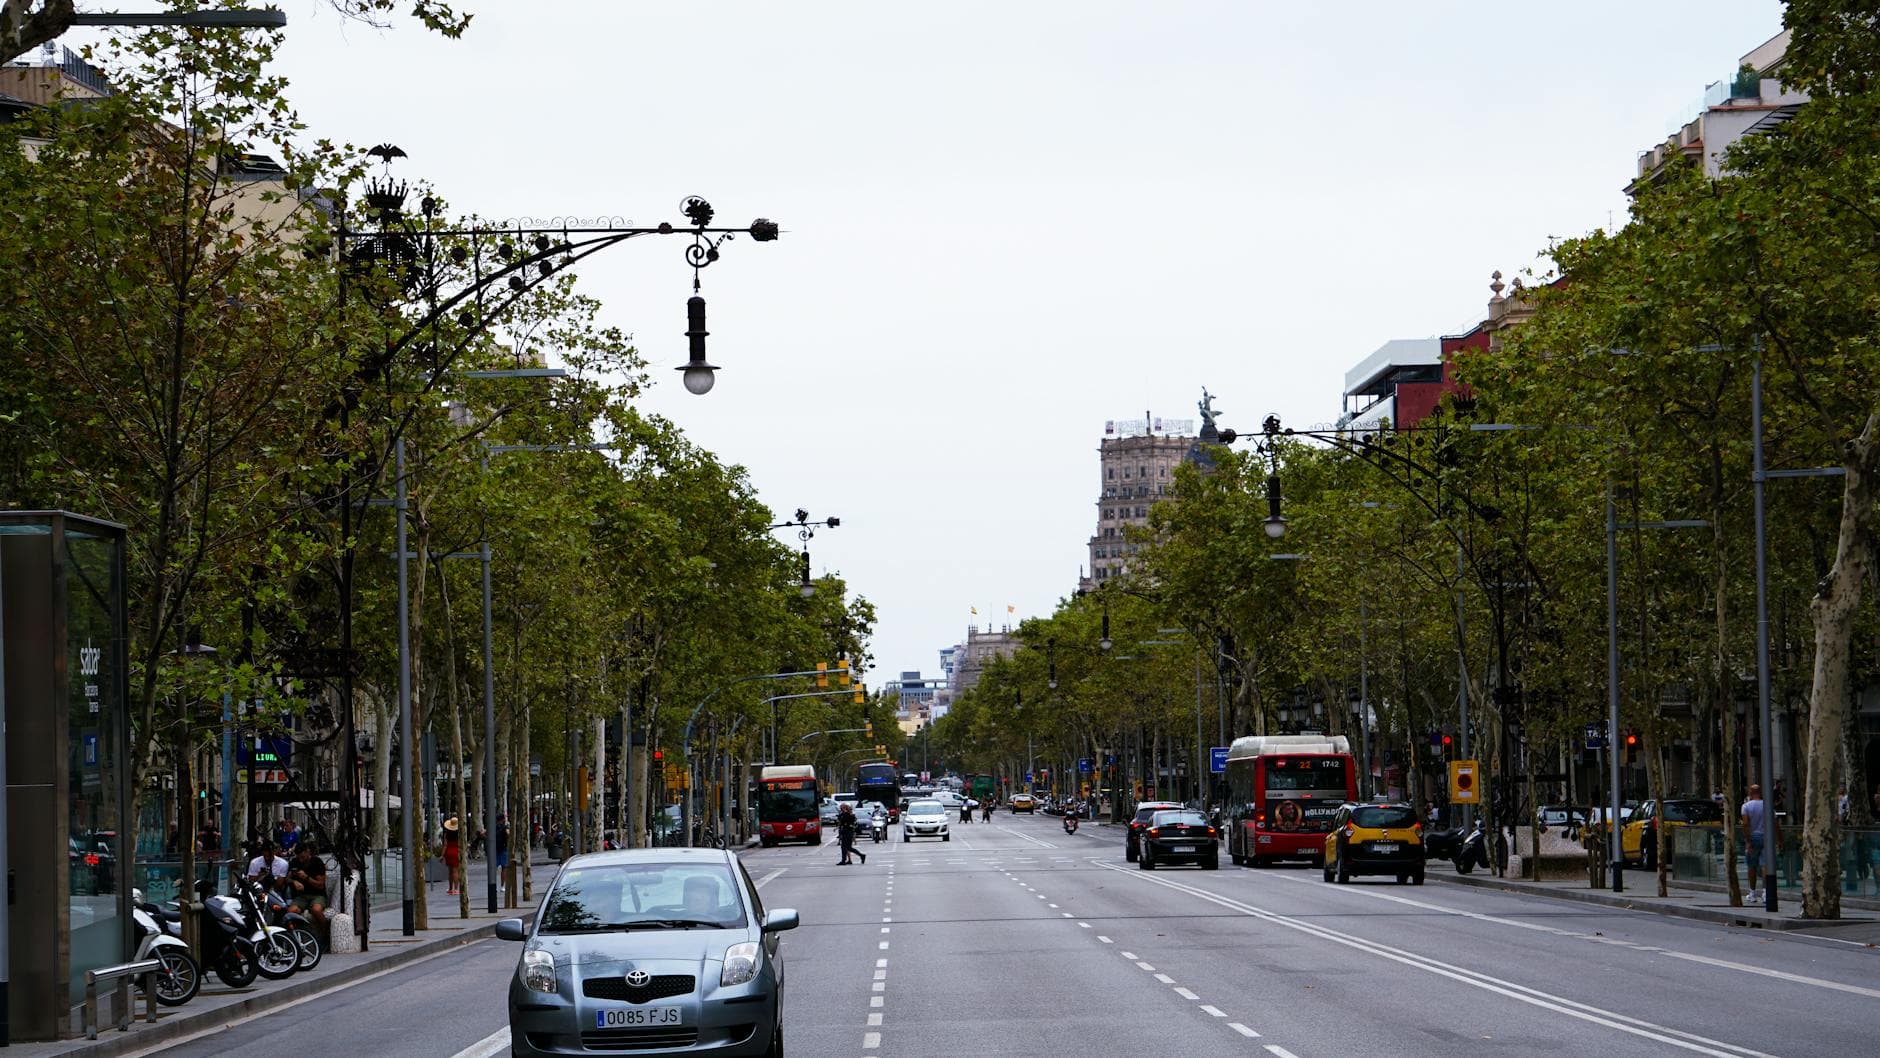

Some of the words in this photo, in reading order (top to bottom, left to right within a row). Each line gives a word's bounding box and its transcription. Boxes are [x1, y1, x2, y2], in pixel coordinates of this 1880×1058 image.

[1300, 761, 1311, 769] 22
[1322, 760, 1340, 768] 1742
[607, 1010, 644, 1025] 0085
[649, 1008, 678, 1023] FJS
